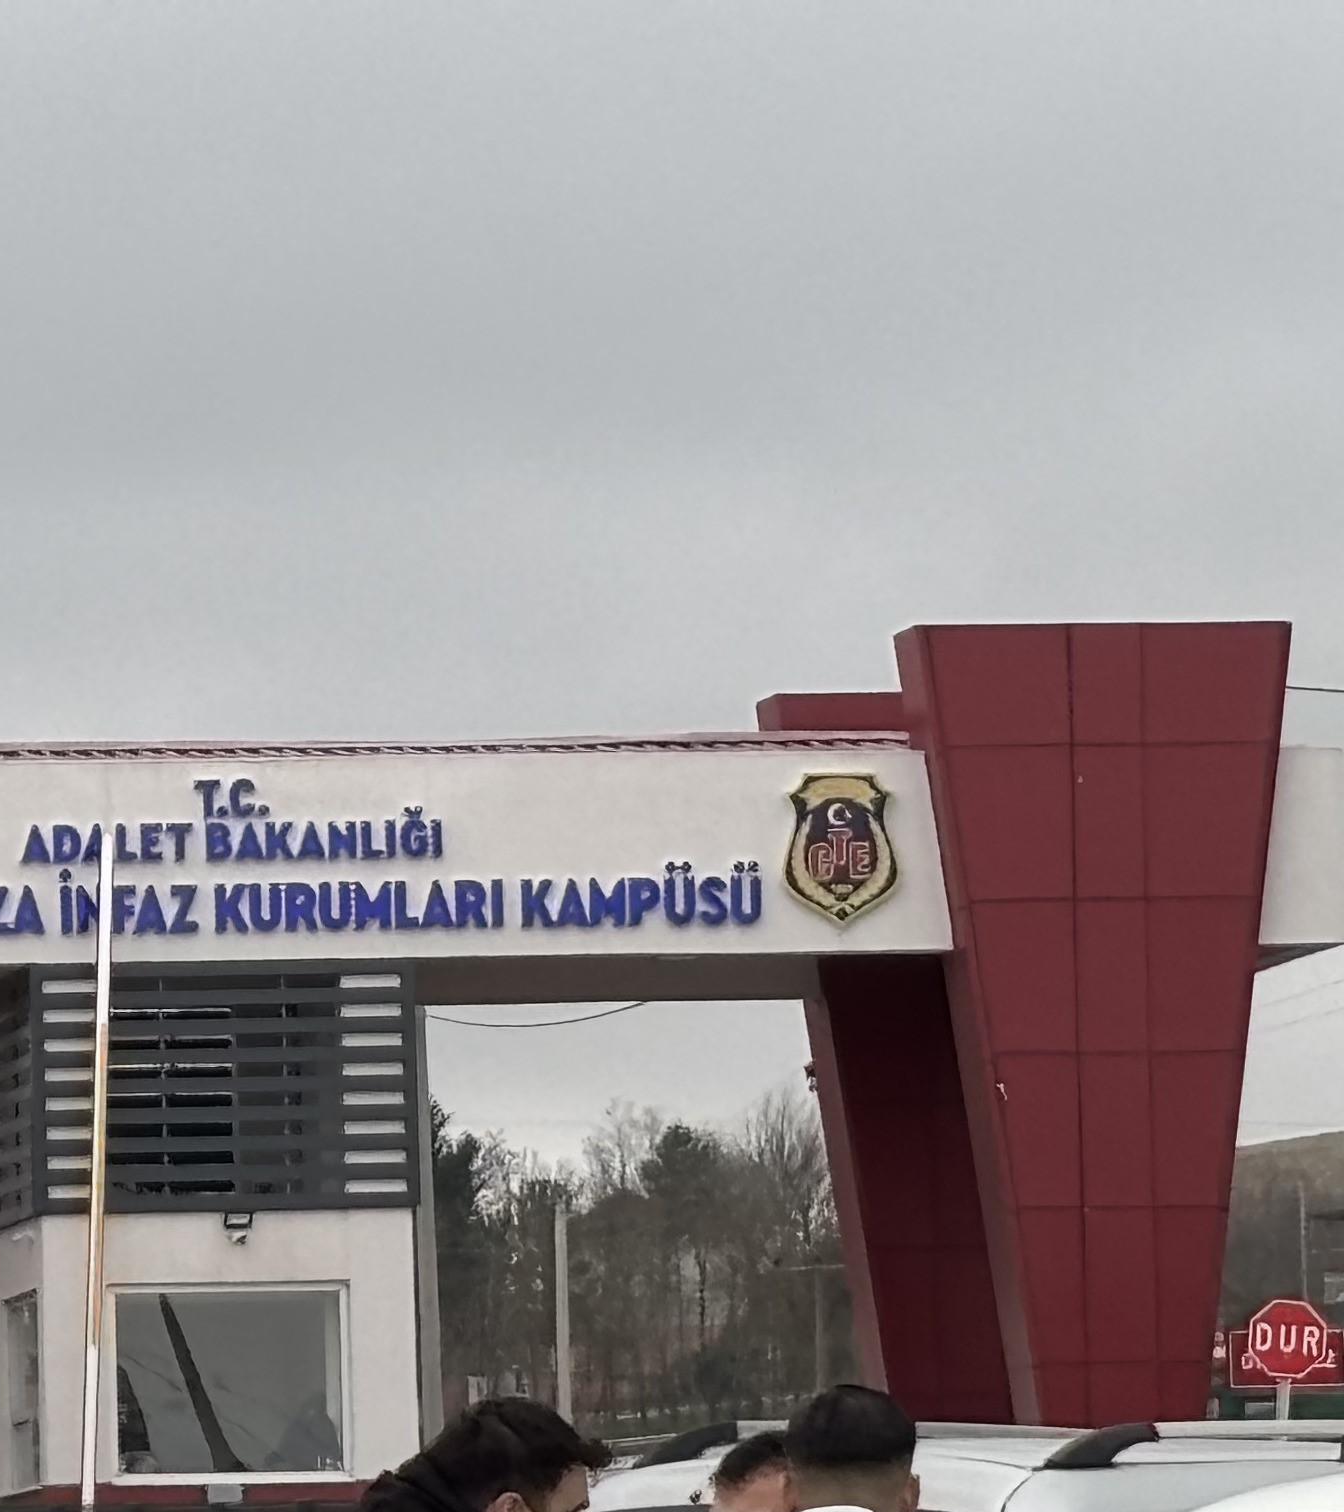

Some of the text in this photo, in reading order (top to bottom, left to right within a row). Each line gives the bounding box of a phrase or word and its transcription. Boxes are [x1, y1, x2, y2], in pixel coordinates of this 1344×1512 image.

[194, 779, 270, 818] T.C.
[20, 806, 443, 864] ADALET BAKANLIĞI
[59, 868, 200, 936] İNFAZ
[214, 879, 505, 935] KURUMLARI
[520, 861, 763, 931] KAMPÜSÜ
[1255, 1322, 1320, 1357] DUR
